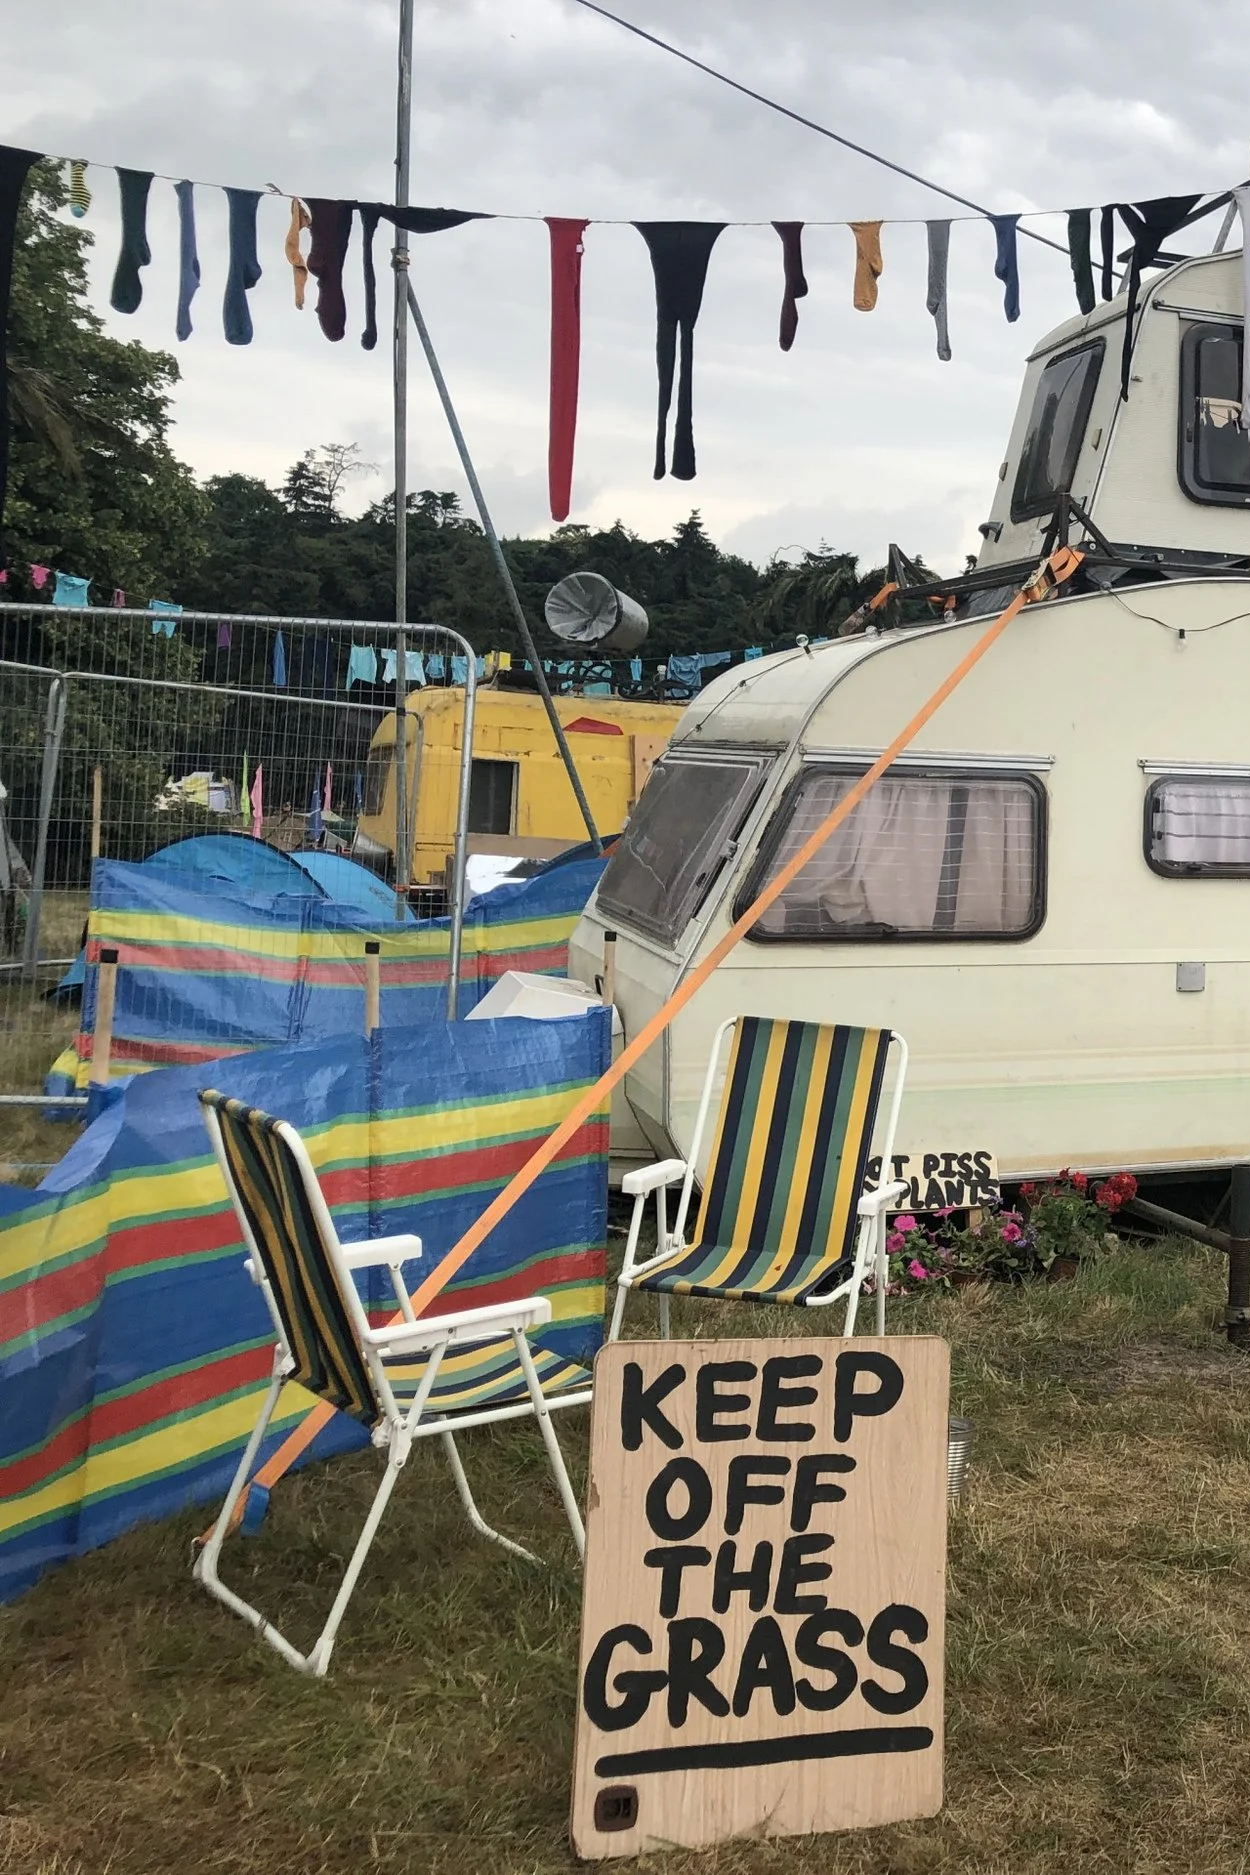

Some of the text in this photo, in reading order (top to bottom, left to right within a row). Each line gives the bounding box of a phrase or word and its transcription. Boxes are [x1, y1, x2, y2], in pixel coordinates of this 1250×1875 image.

[894, 1175, 1000, 1208] PLANTS
[922, 1150, 993, 1180] PISS
[621, 1351, 904, 1451] KEEP
[645, 1453, 857, 1541] OFF
[643, 1532, 836, 1619] THE
[584, 1603, 929, 1732] GRASS
